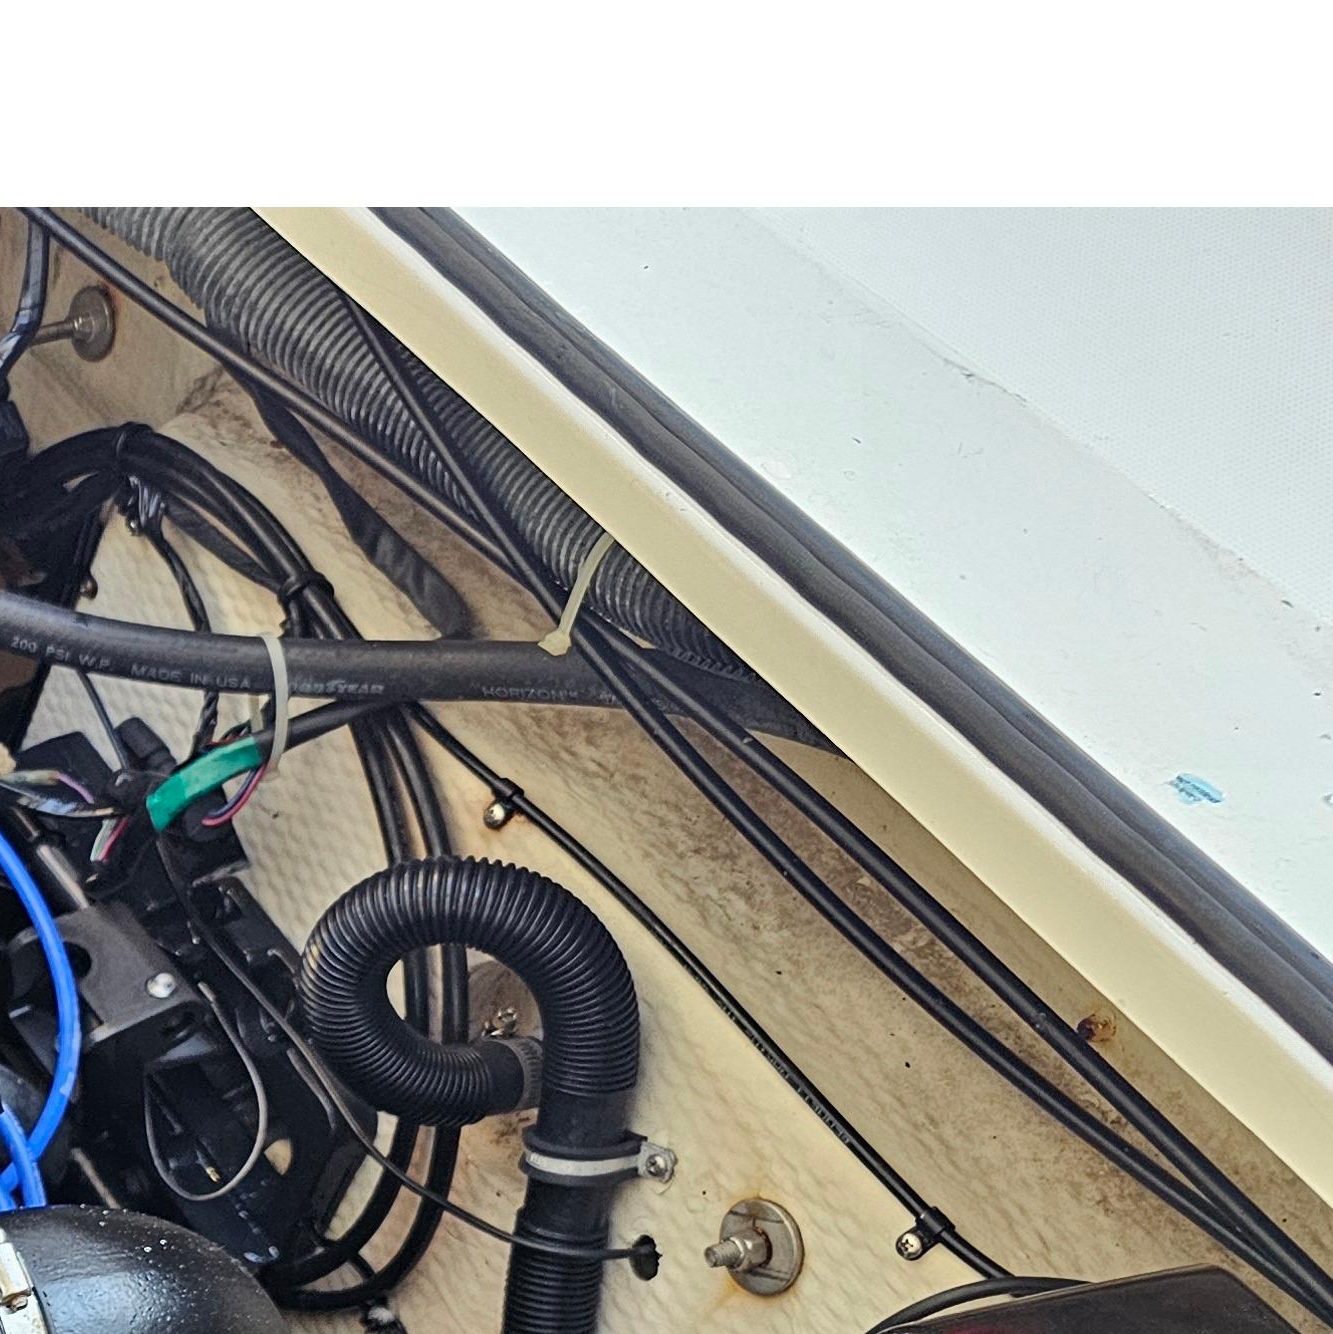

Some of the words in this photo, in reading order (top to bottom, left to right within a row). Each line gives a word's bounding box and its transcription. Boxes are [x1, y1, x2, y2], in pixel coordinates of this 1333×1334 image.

[11, 636, 37, 652] 200
[46, 646, 70, 661] PSI
[131, 665, 182, 684] MADE
[190, 672, 209, 686] IN
[216, 674, 253, 690] USA
